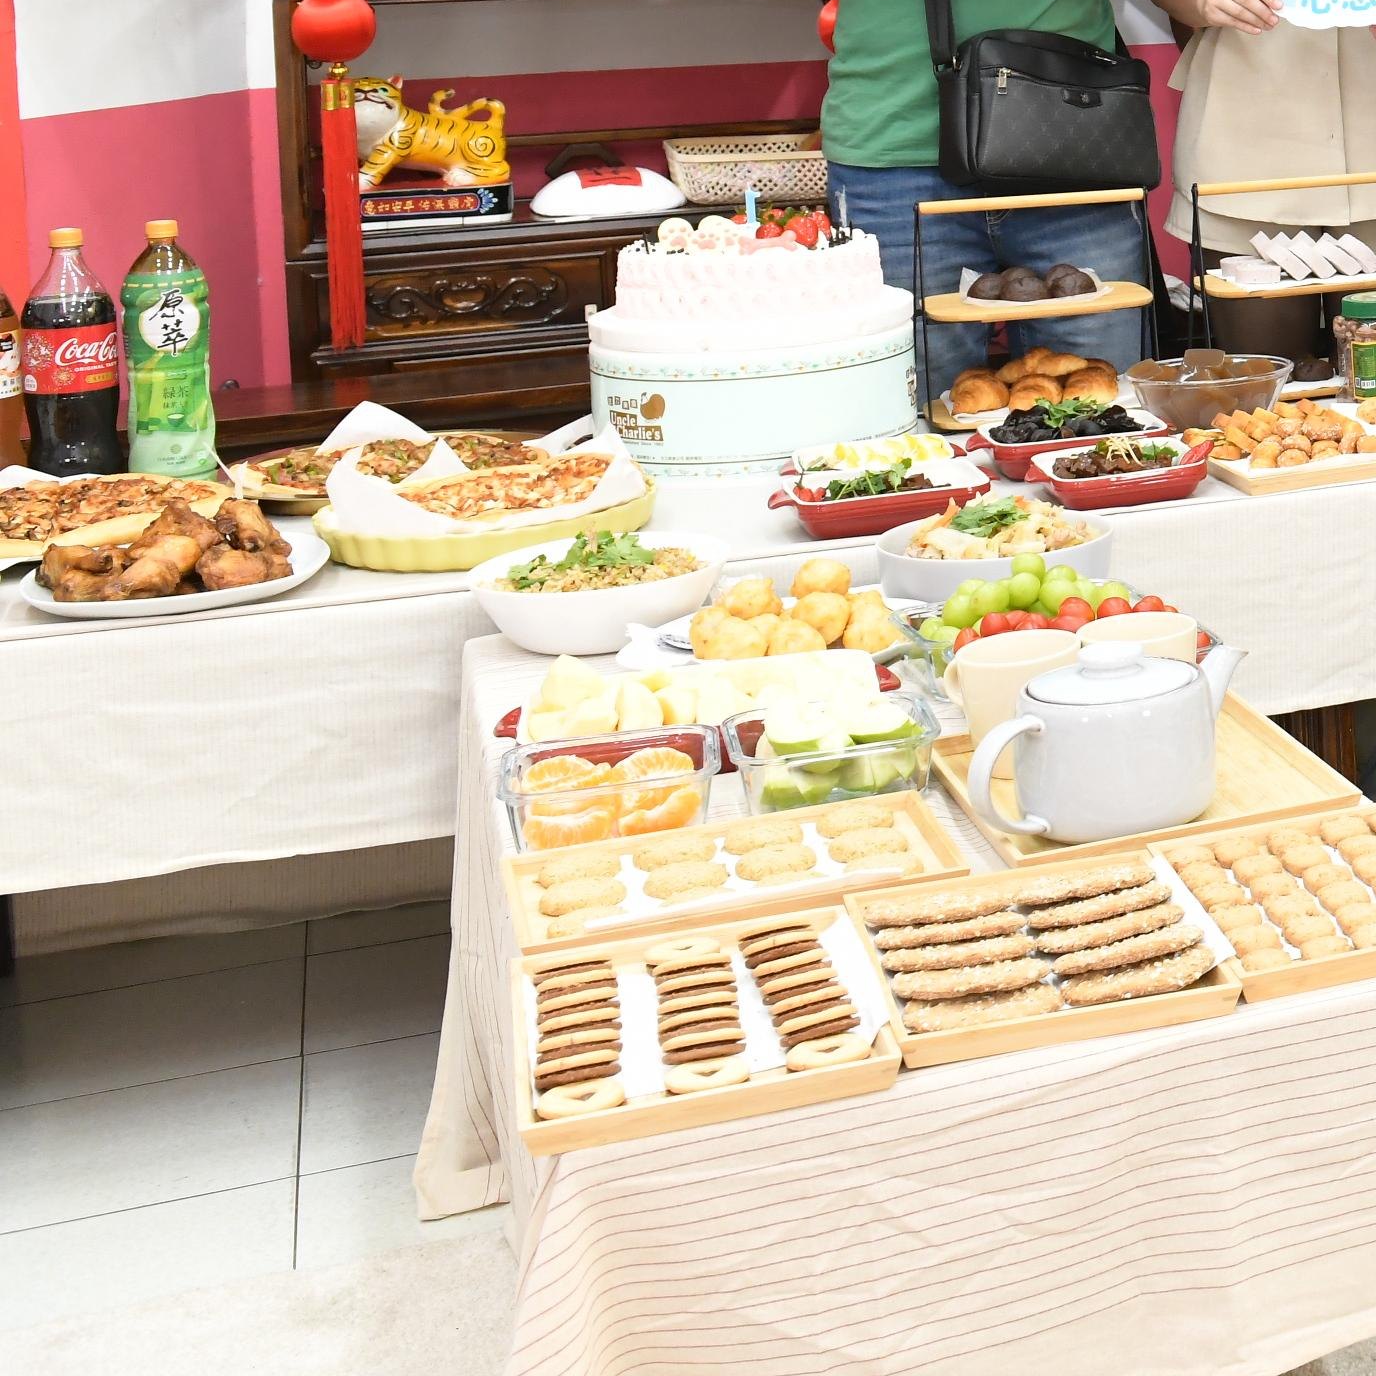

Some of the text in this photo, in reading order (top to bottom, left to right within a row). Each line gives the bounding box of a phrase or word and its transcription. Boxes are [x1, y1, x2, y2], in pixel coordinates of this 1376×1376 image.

[148, 287, 189, 357] 原萃
[611, 411, 636, 426] Uncle
[616, 425, 661, 441] Charlie's
